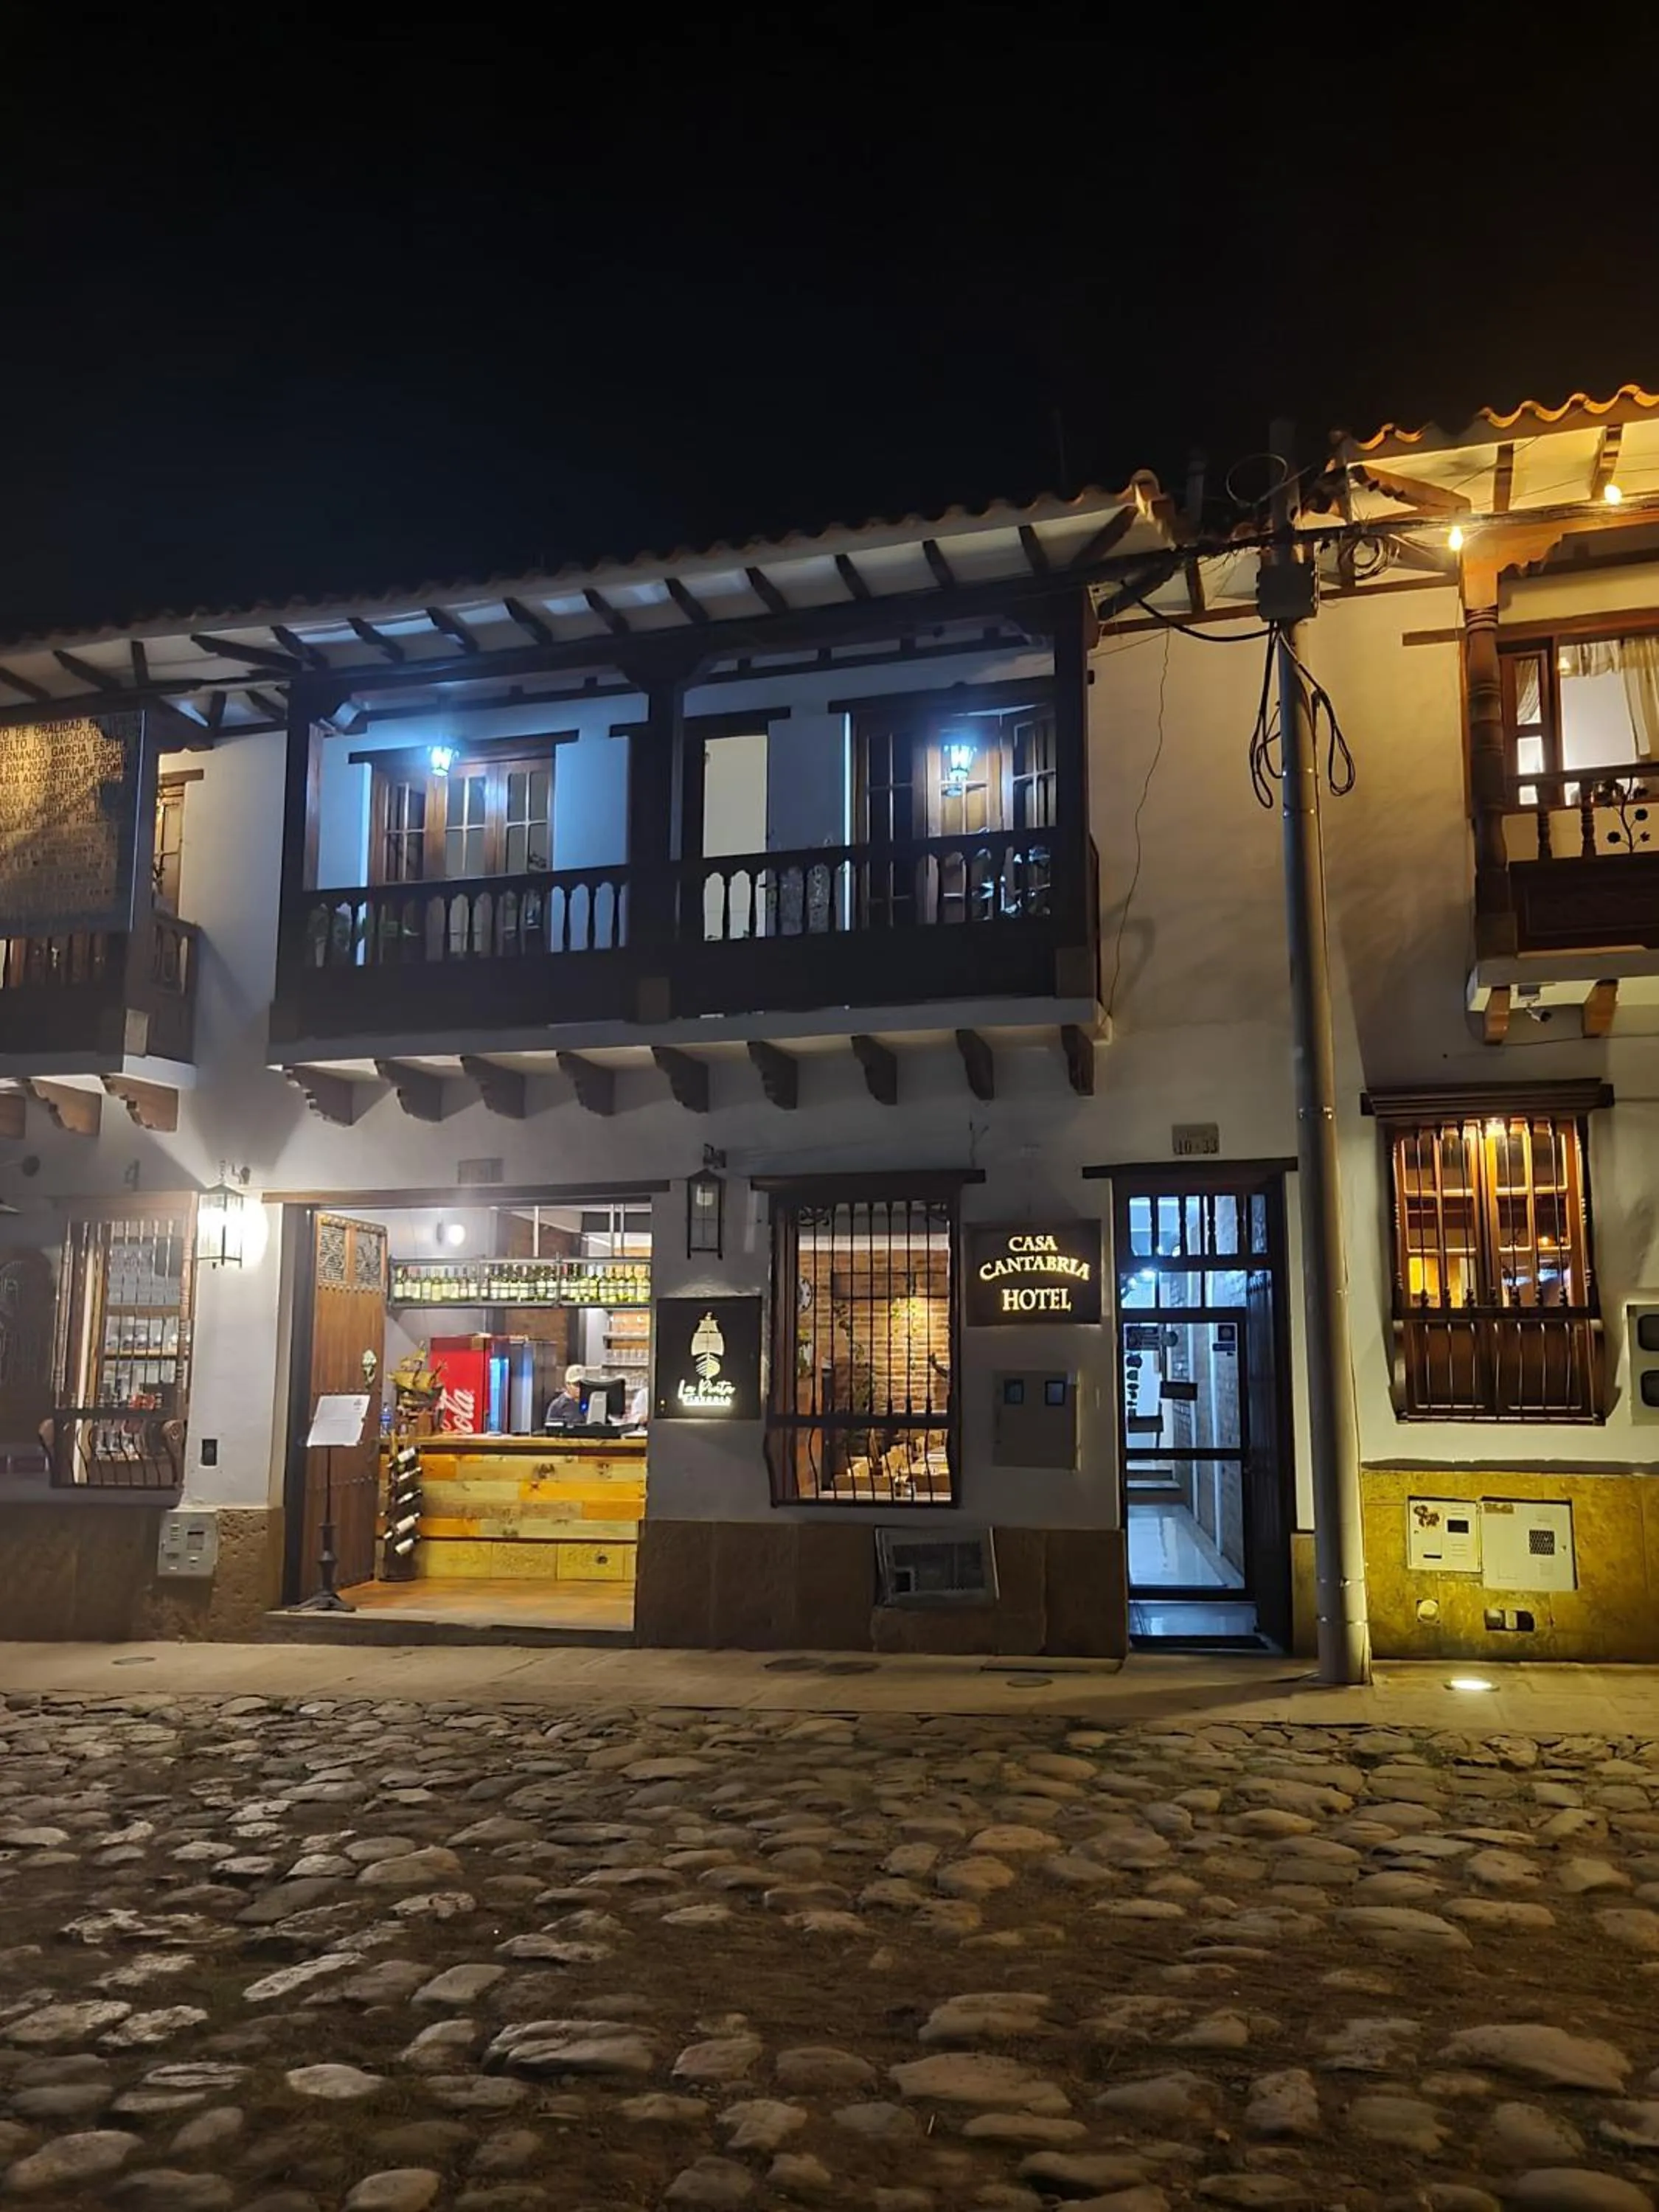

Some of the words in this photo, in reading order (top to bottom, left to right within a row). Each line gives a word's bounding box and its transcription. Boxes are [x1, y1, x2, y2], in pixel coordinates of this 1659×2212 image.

[15, 727, 28, 738] DE
[34, 720, 82, 737] ORALIDAD
[33, 730, 100, 748] DEMANDADOS
[51, 743, 86, 757] GARCIA
[84, 765, 96, 777] DE
[1009, 1235, 1058, 1252] CASA
[979, 1255, 1091, 1281] CANTABRIA
[1002, 1288, 1071, 1312] HOTEL
[678, 1379, 697, 1399] La
